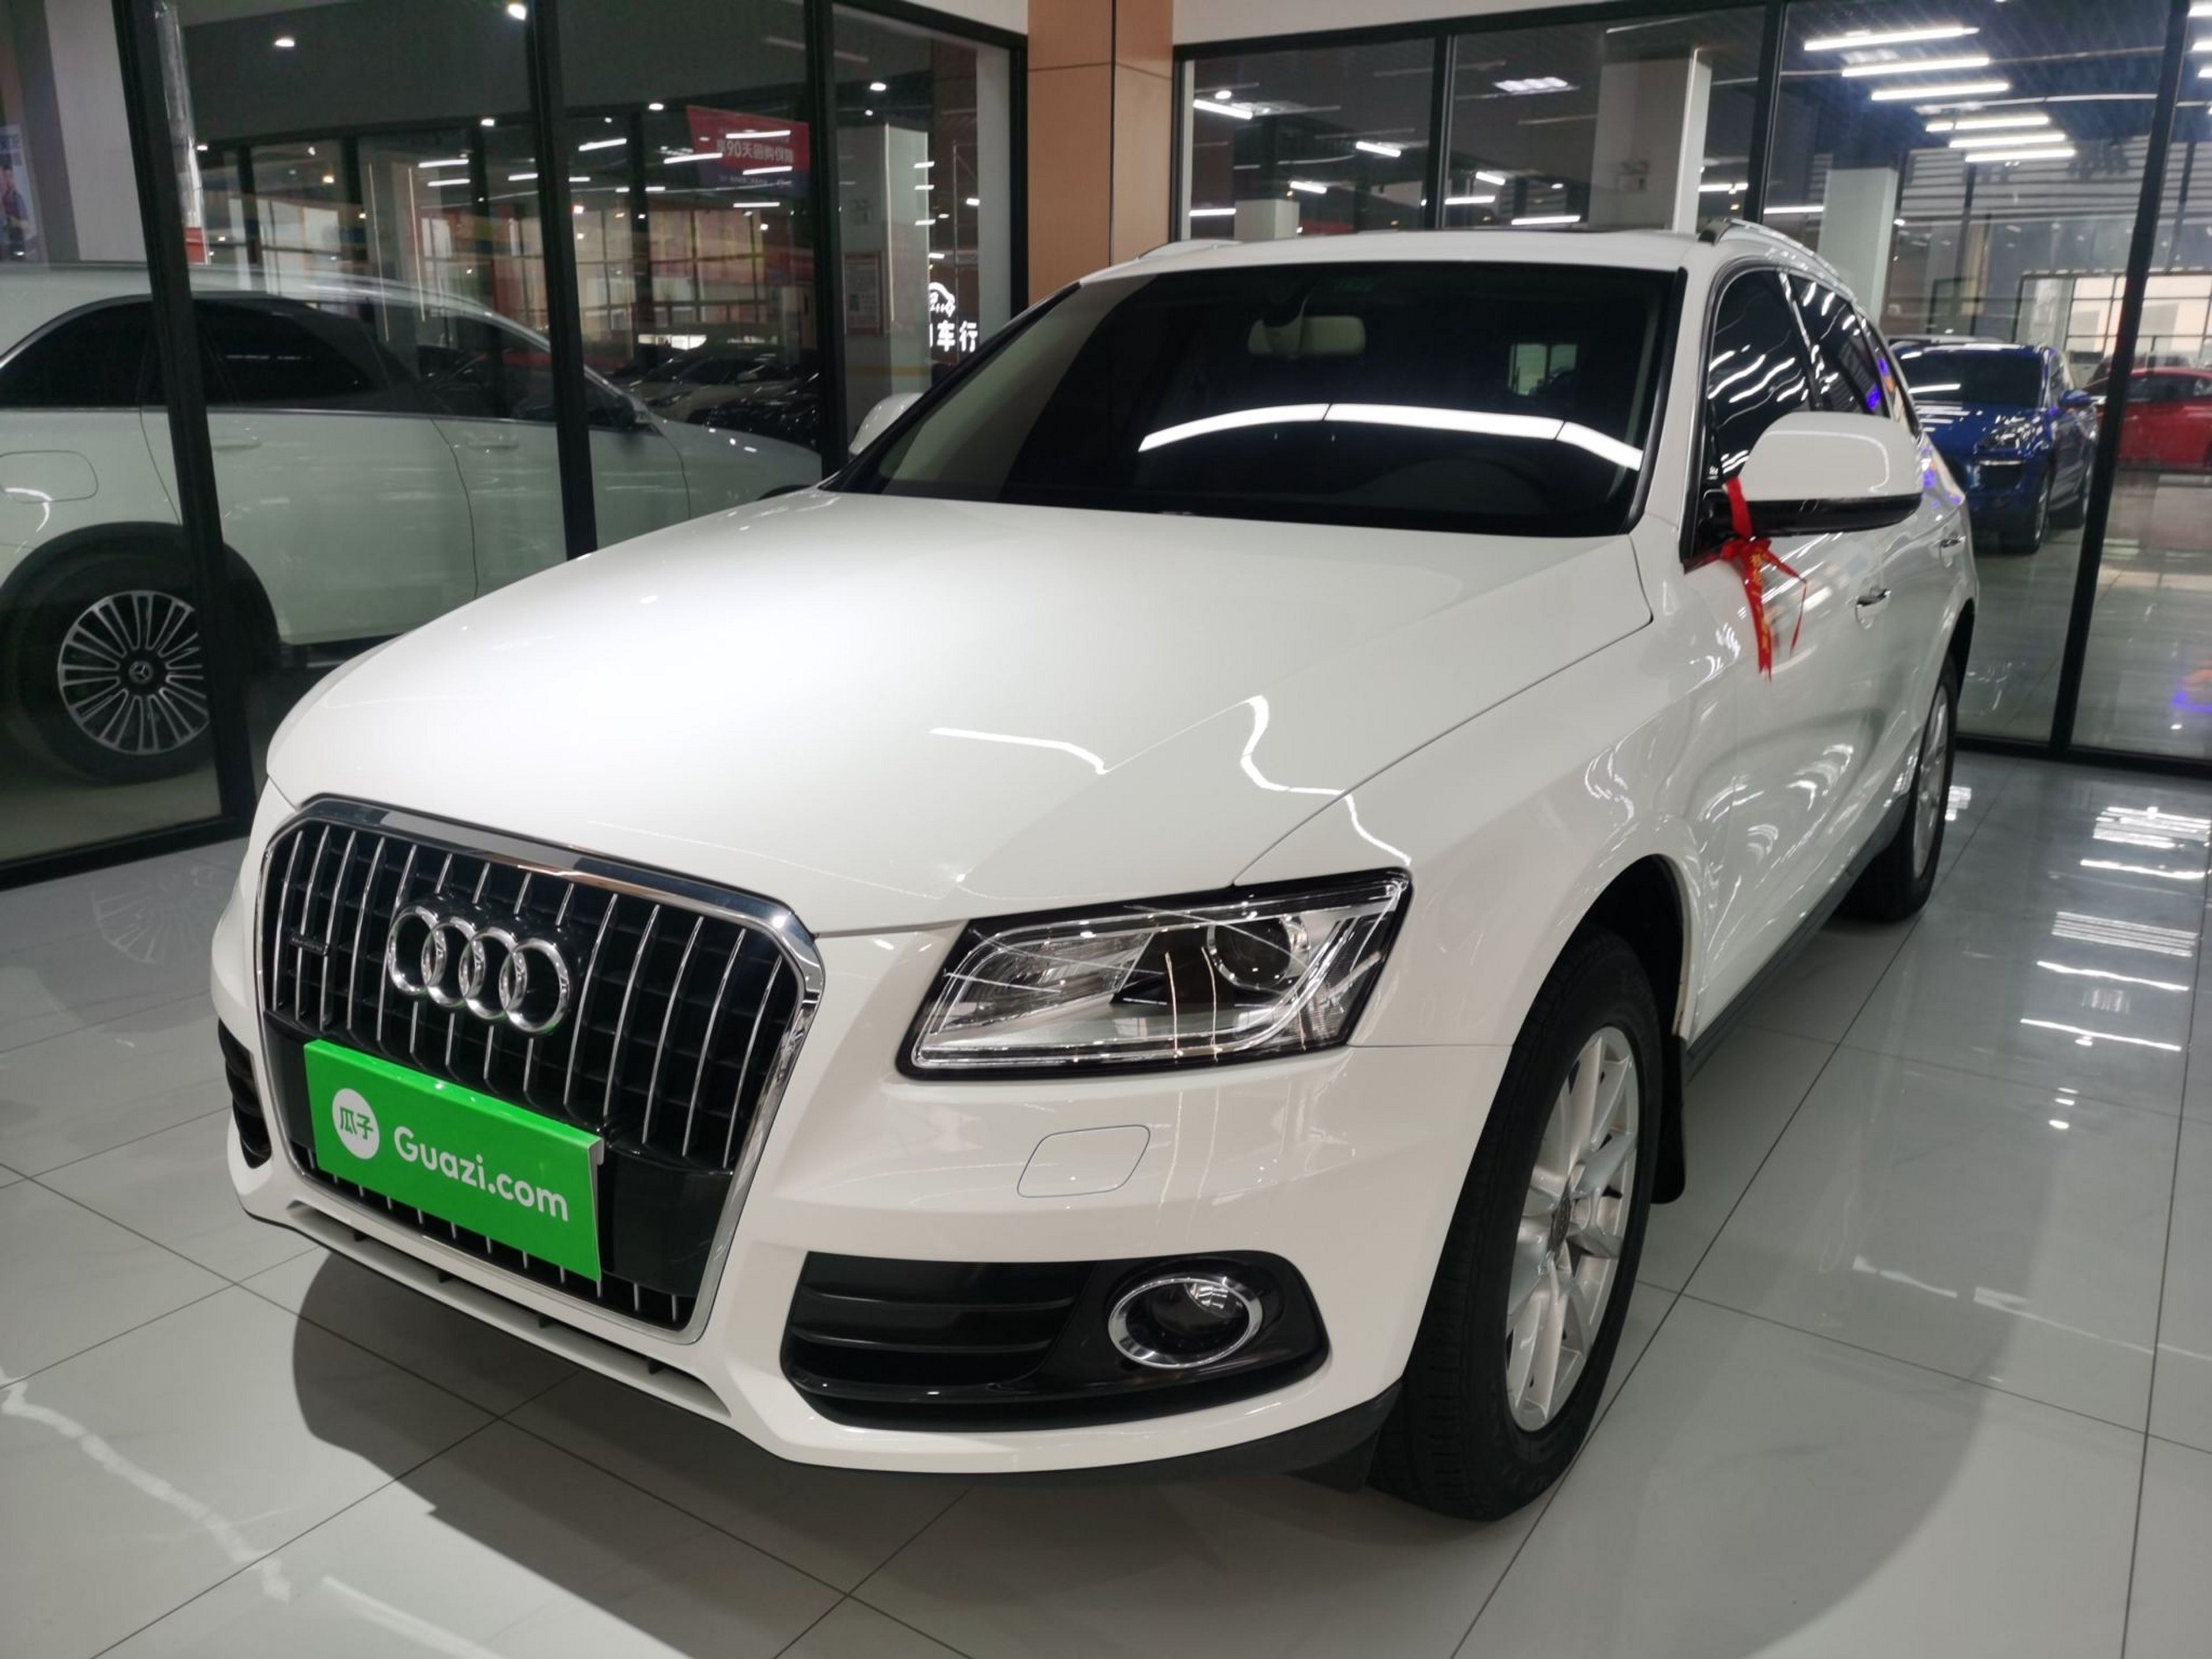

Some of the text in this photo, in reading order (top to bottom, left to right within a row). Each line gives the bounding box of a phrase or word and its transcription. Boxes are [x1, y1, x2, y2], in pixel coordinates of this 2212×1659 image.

[929, 320, 978, 353] 车行
[339, 1106, 374, 1141] 瓜子
[393, 1126, 569, 1222] Guazi.com
